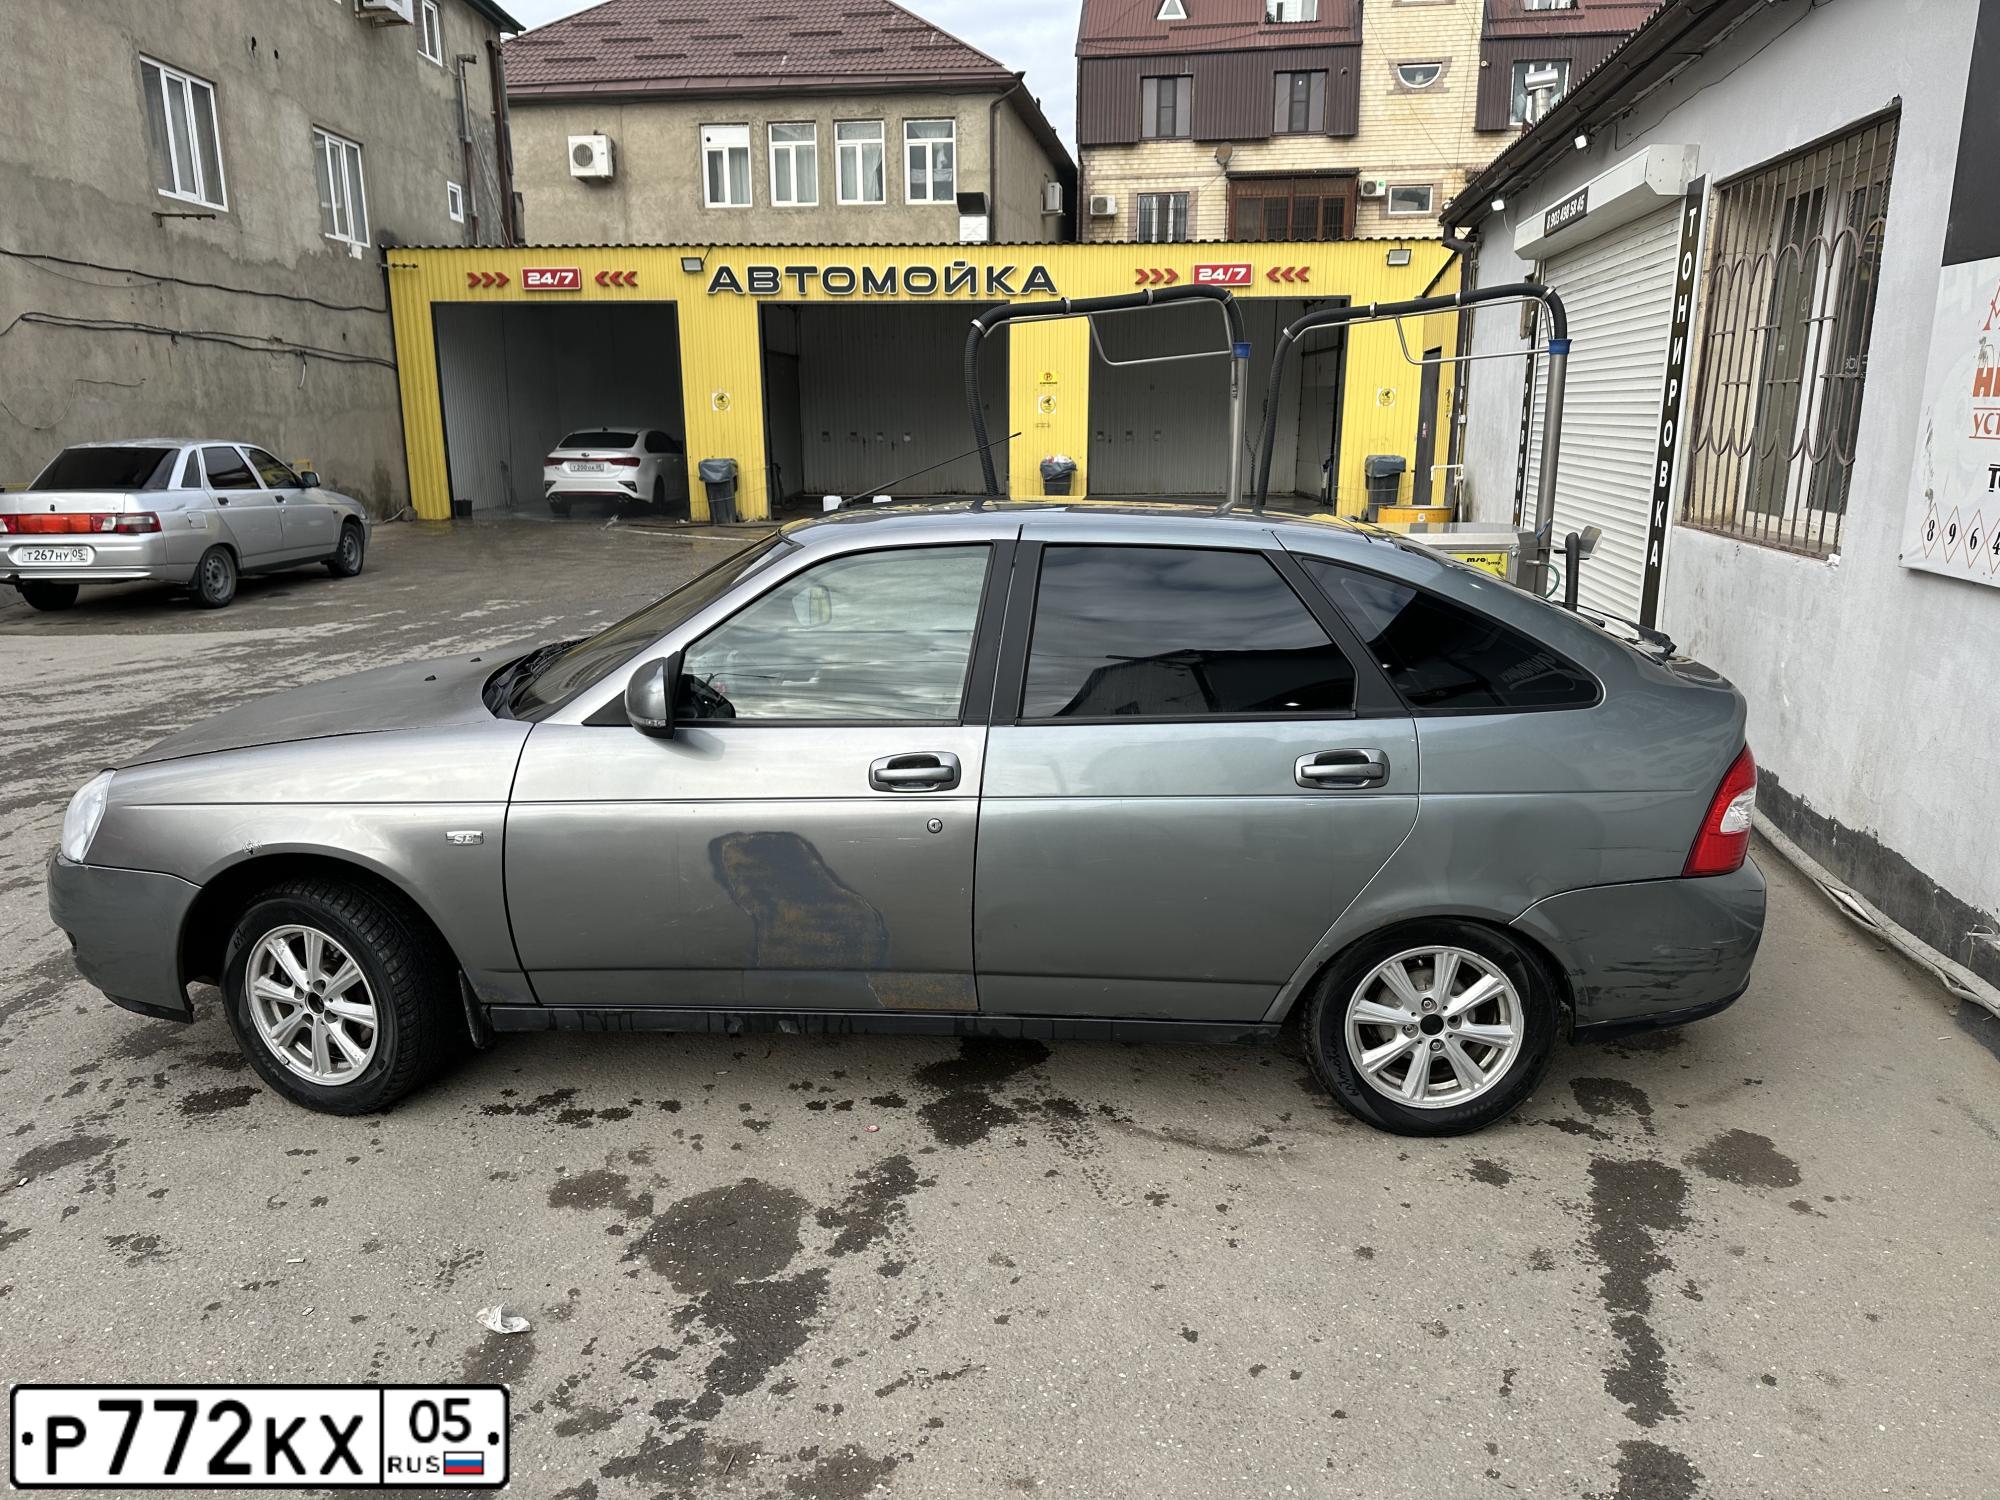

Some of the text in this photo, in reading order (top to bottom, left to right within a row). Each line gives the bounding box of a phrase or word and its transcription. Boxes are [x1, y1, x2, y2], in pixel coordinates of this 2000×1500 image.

[526, 271, 575, 285] 24/7
[707, 260, 1060, 295] АВТОМОЙКА
[1198, 267, 1247, 281] 24/7
[1649, 207, 1697, 568] ТОНИРОВКА
[26, 549, 84, 561] Т267НУ 05
